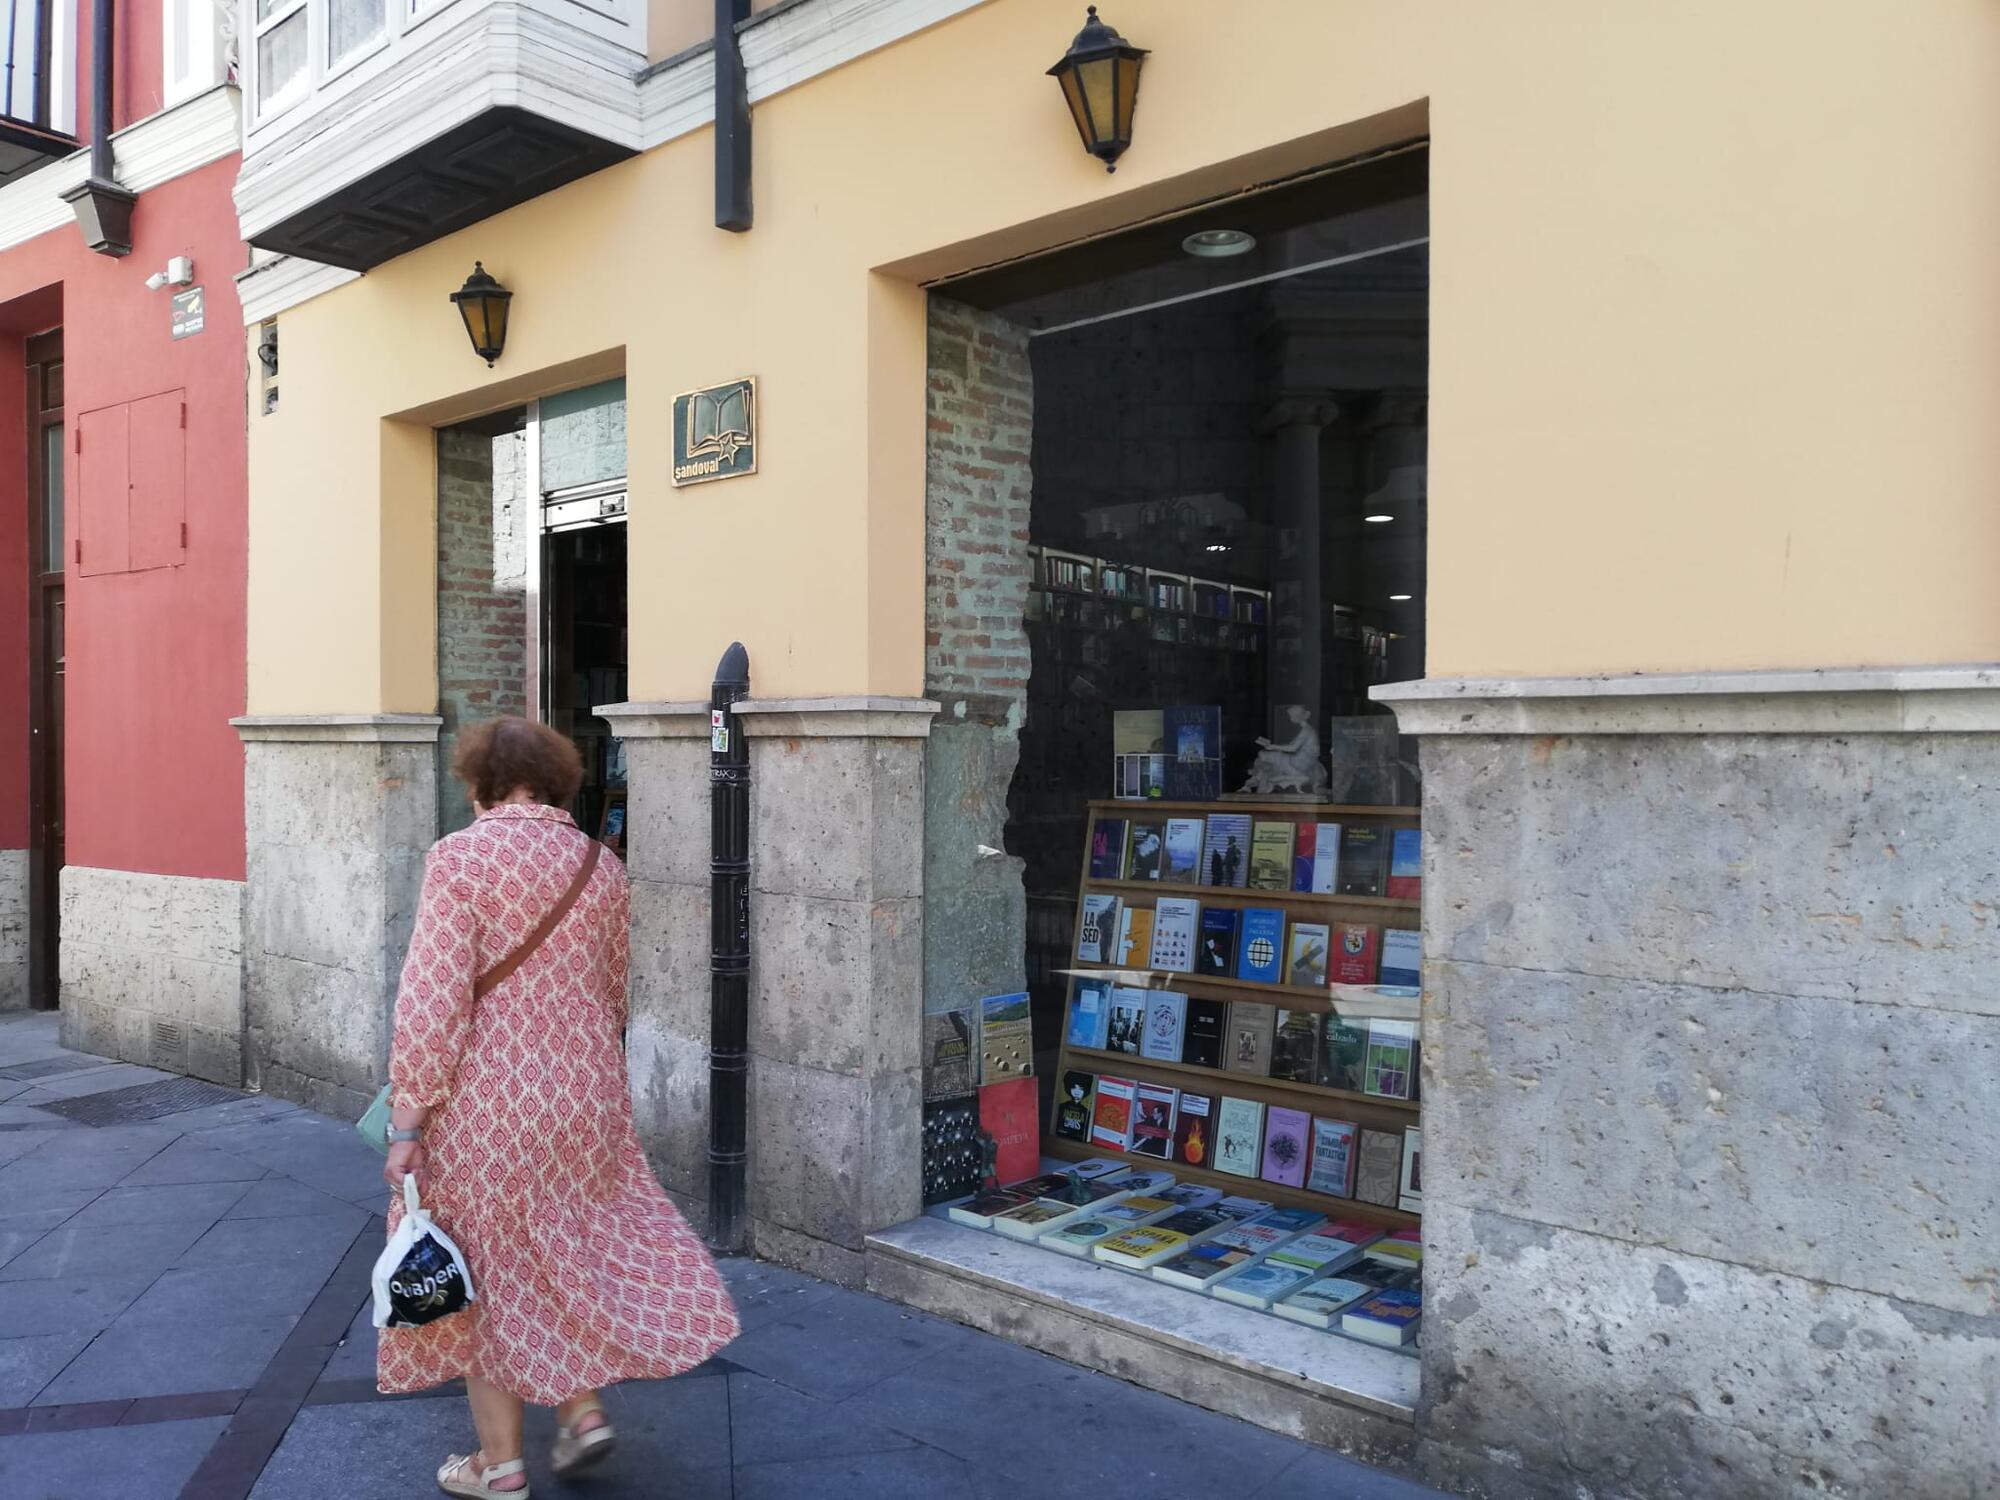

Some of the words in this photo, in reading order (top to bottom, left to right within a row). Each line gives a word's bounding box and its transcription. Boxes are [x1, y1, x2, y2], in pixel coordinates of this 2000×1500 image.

[674, 457, 719, 479] sandoval
[1084, 911, 1095, 927] LA
[1082, 928, 1099, 943] SED
